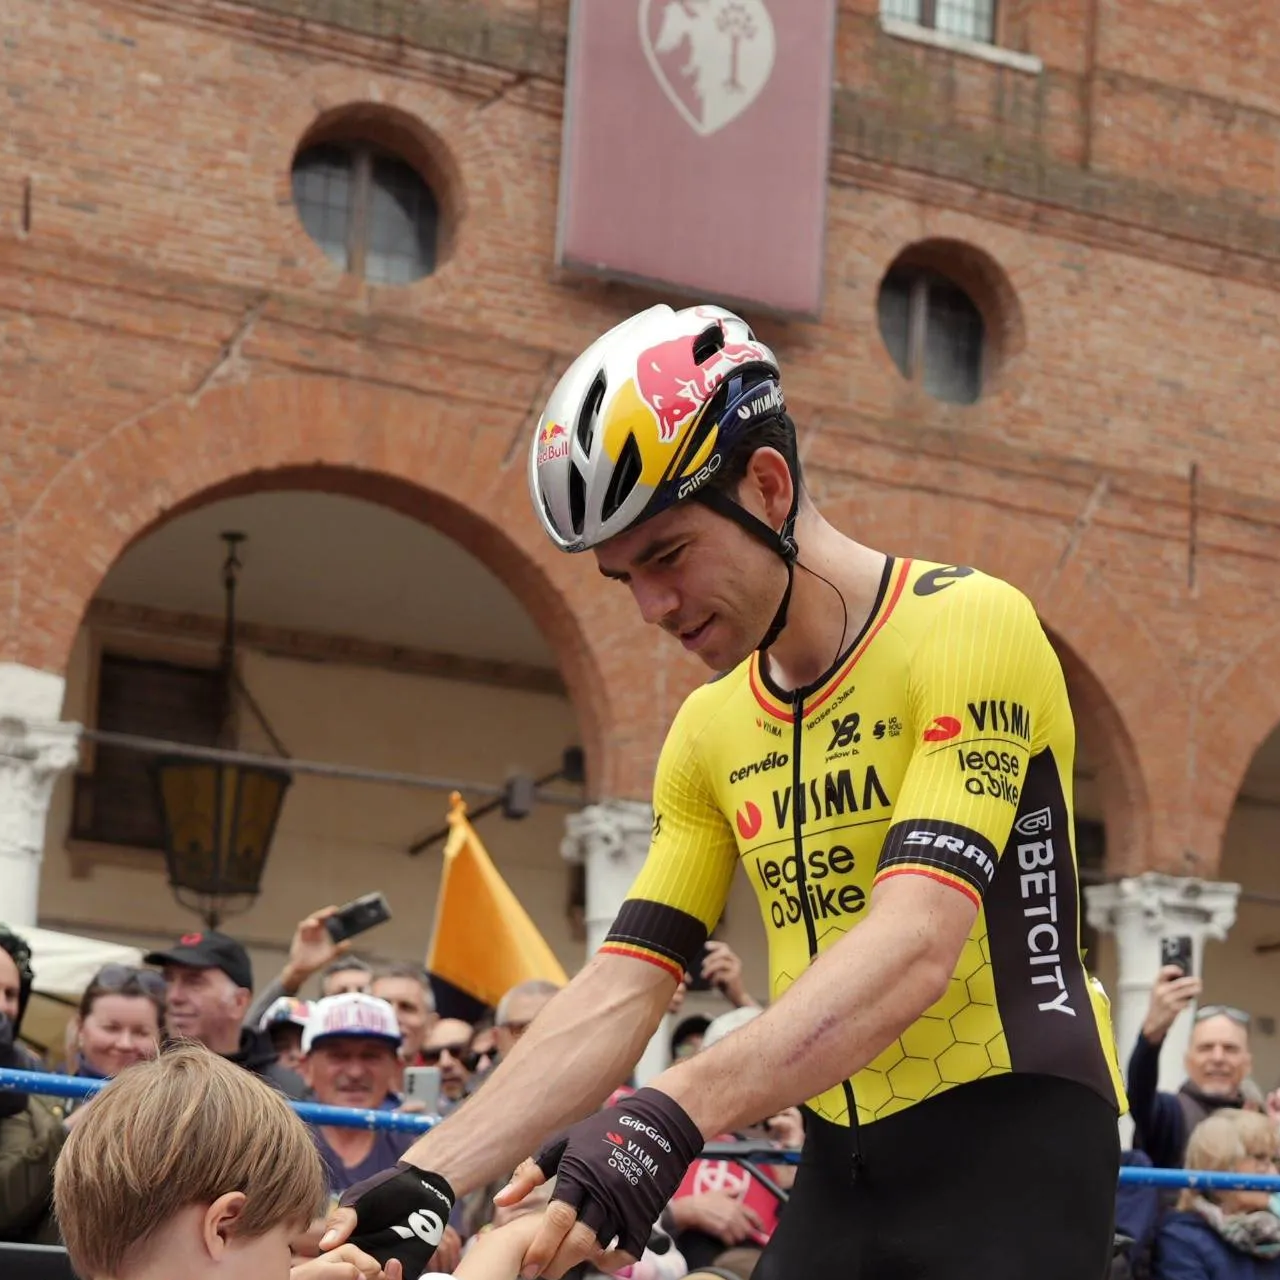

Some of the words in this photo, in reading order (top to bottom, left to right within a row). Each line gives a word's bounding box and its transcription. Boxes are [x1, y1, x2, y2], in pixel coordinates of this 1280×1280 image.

[678, 453, 722, 499] GIRO
[763, 721, 782, 738] VISMA
[968, 700, 1030, 743] VISMA
[730, 751, 789, 784] cervélo
[958, 749, 1020, 777] lease
[772, 765, 891, 829] VISMA
[756, 845, 855, 890] lease
[903, 830, 996, 883] SRAM
[1017, 838, 1077, 1017] BETCITY
[618, 1115, 672, 1153] GripGrab
[611, 1148, 643, 1177] lease
[626, 1140, 659, 1177] VISMA
